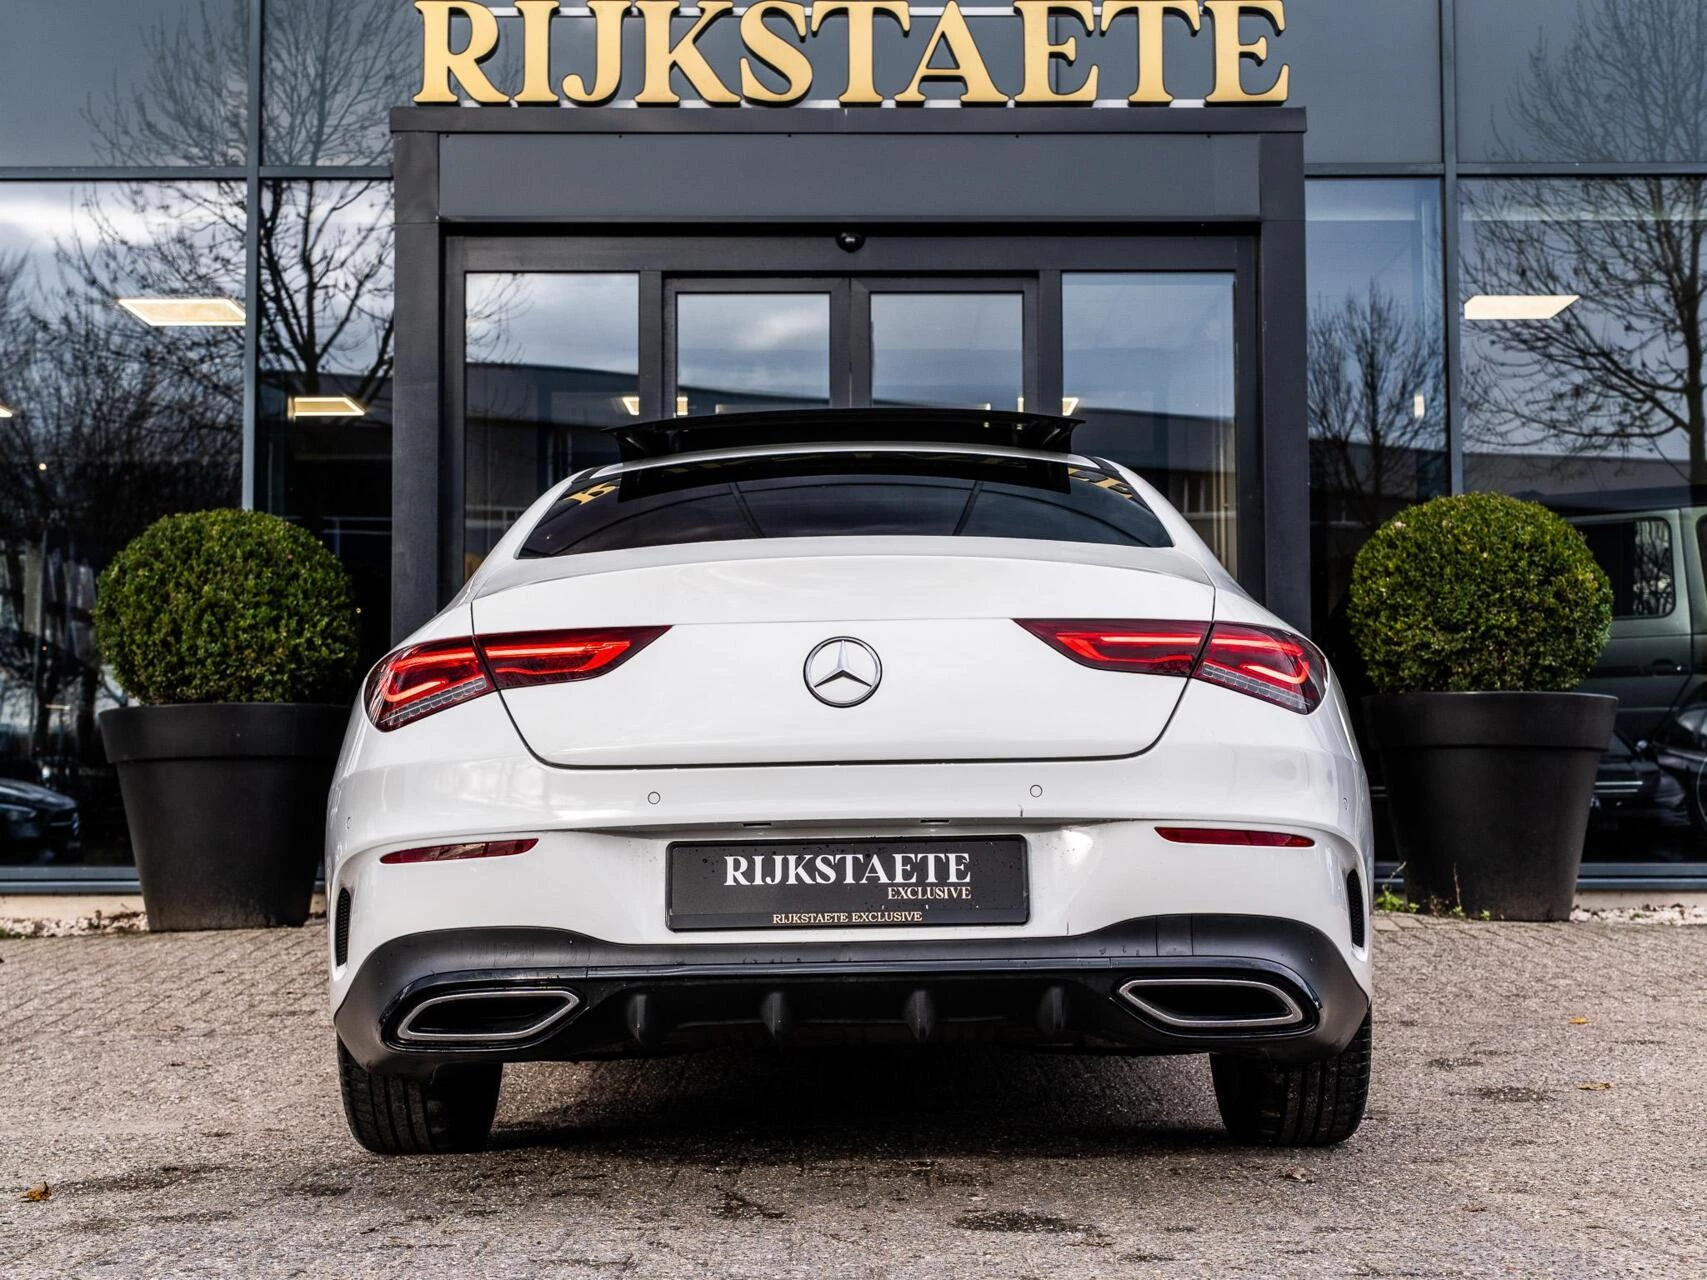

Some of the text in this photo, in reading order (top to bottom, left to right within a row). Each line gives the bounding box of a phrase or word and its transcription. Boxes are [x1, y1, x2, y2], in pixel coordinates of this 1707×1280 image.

[413, 0, 1290, 105] RIJKSTAETE
[724, 853, 971, 886] RIJKSTAETE
[887, 887, 972, 900] EXCLUSIVE
[772, 911, 923, 925] RIJKSTAETE EXCLUSIVE
